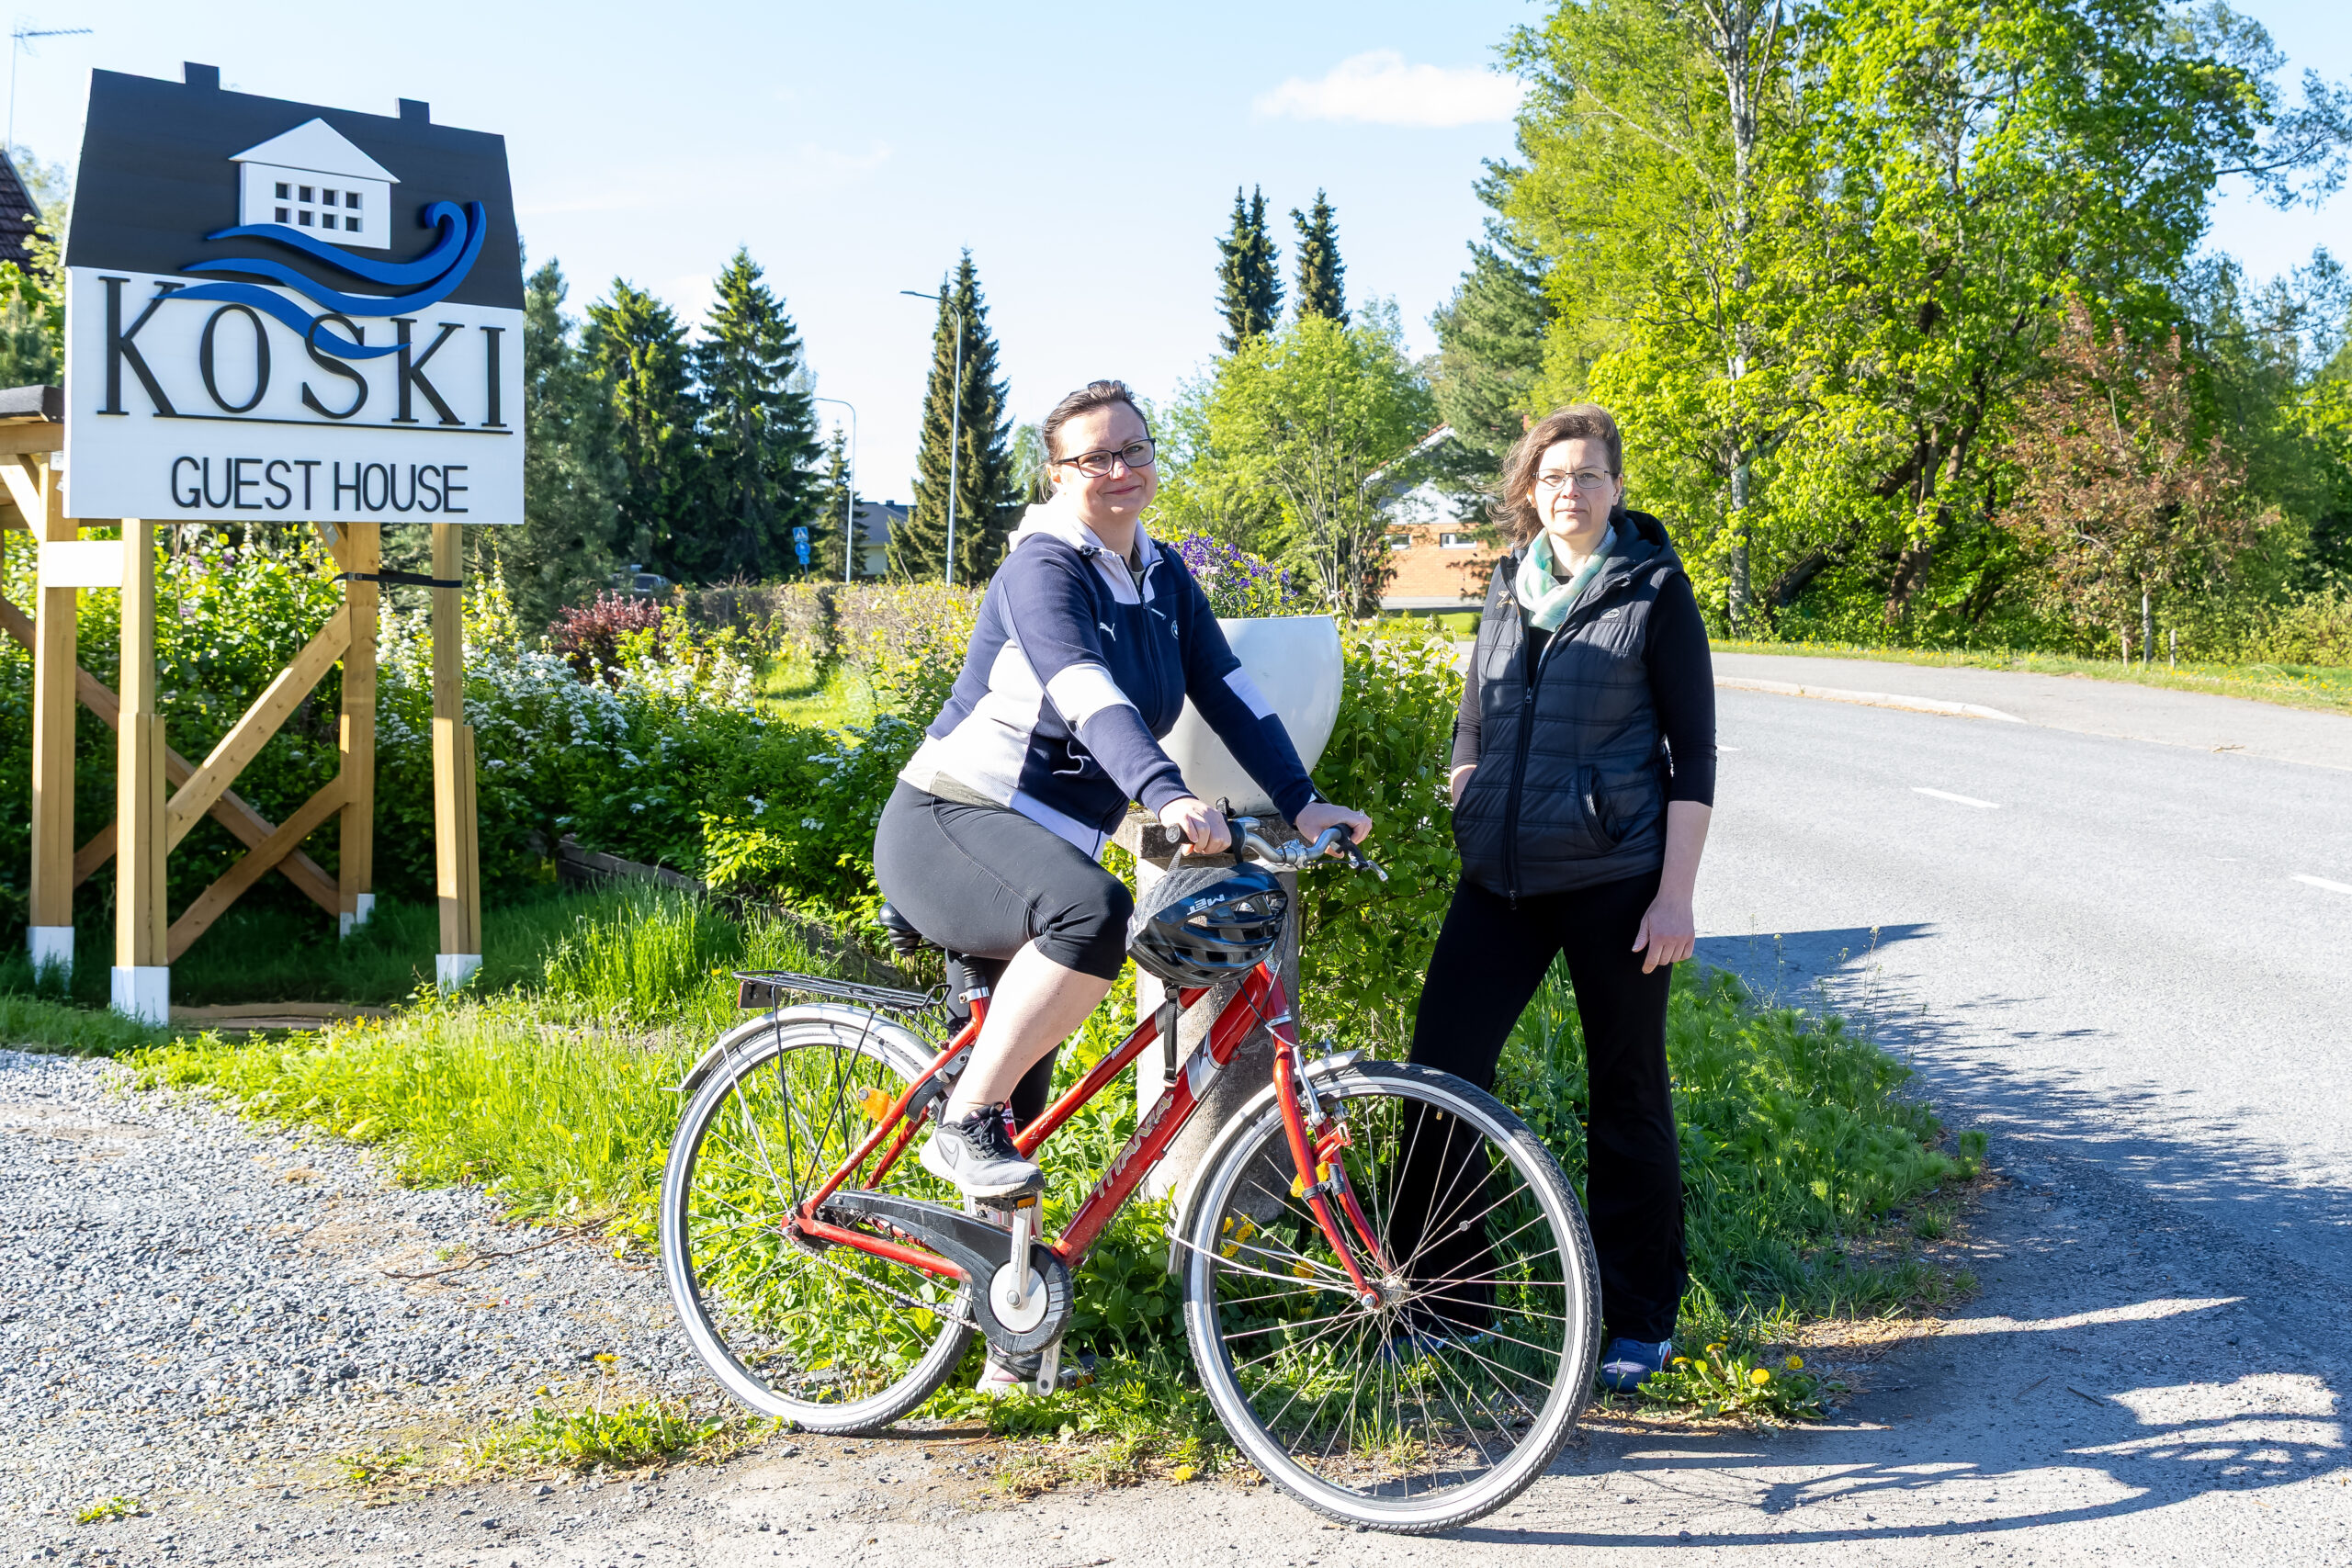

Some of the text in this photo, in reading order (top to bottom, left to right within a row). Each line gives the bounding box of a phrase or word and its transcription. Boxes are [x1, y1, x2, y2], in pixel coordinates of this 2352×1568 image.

[97, 276, 507, 428] KOSKI
[172, 457, 469, 513] GUEST HOUSE
[1186, 894, 1226, 916] MET
